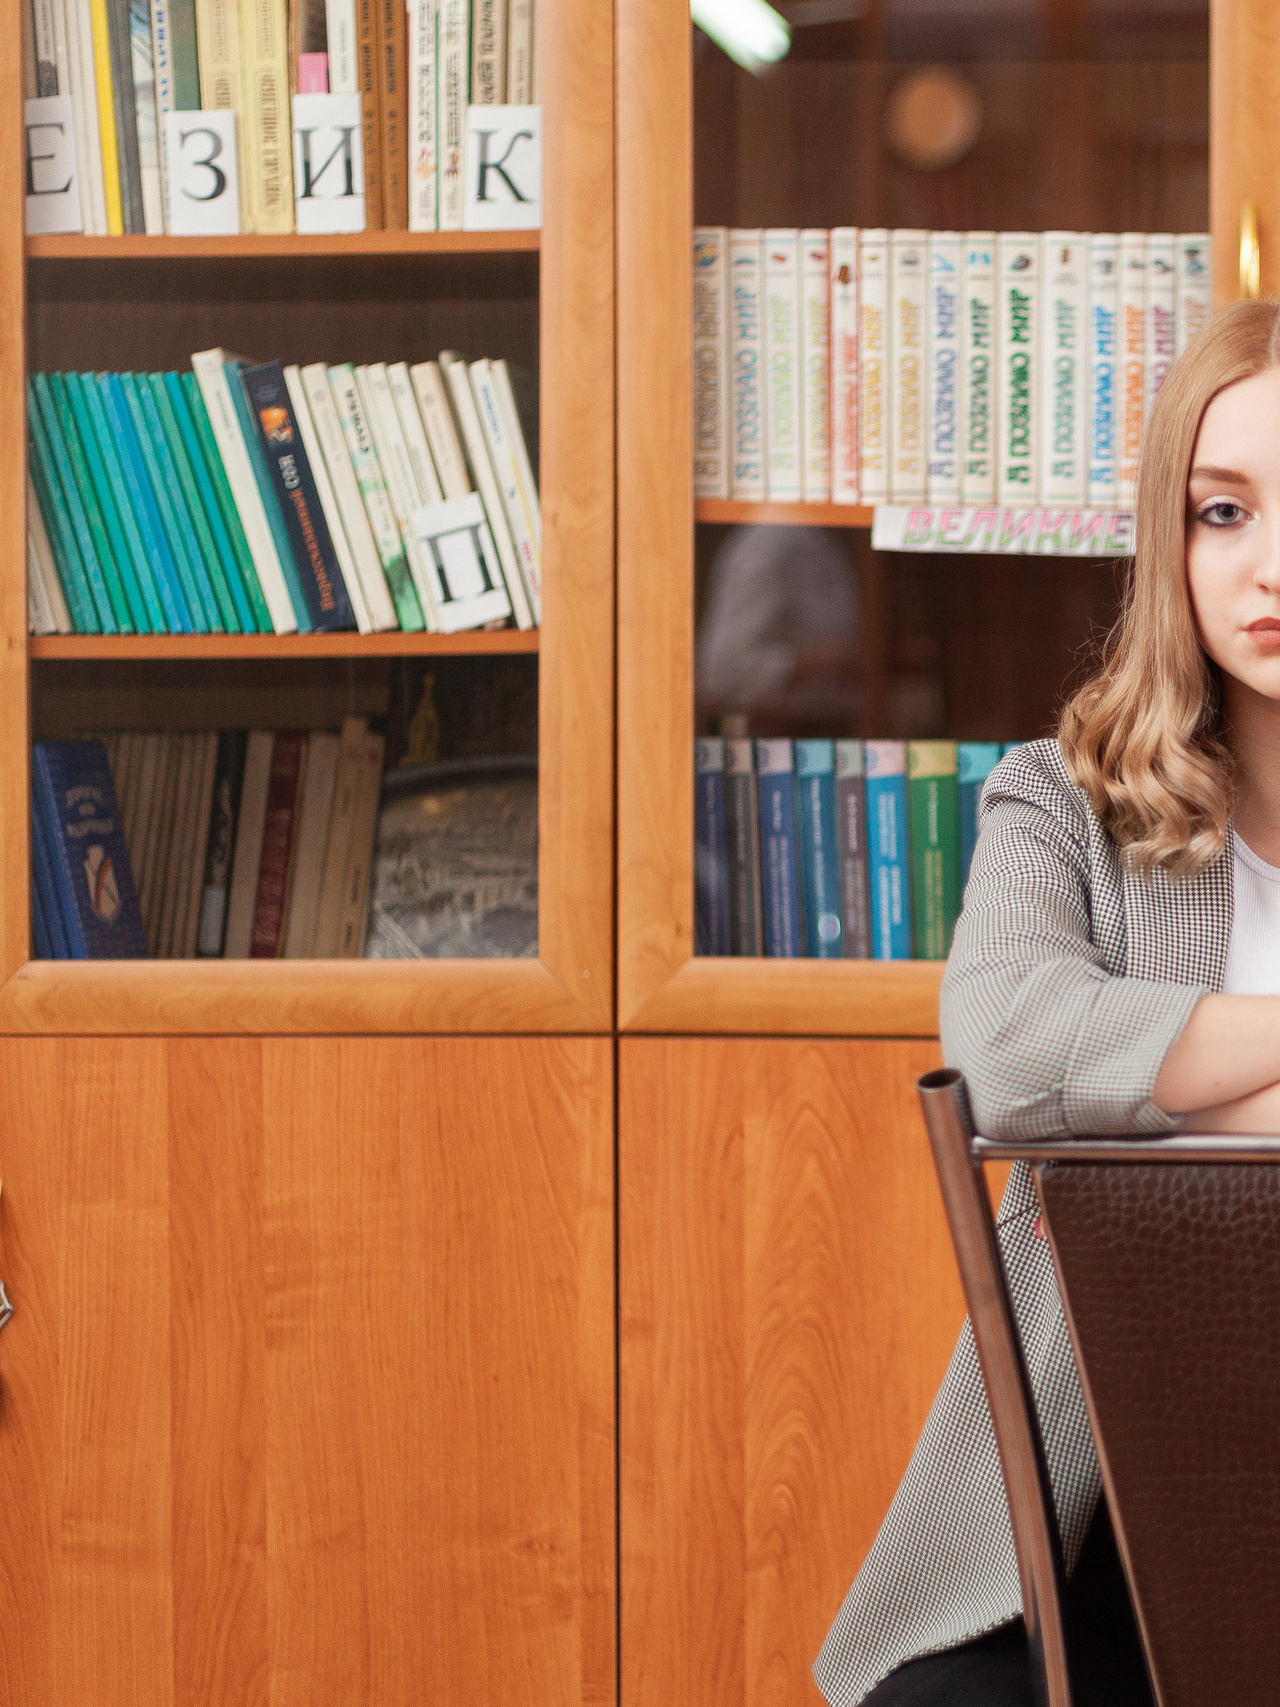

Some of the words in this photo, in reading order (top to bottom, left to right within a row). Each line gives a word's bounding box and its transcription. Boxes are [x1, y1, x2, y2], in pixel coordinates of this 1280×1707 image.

[26, 122, 73, 196] Е
[179, 127, 228, 203] З
[295, 125, 363, 199] И
[474, 129, 535, 203] К
[735, 286, 757, 340] МИР
[935, 285, 956, 339] МИР
[970, 298, 990, 348] МИР
[1009, 288, 1031, 344] МИР
[1055, 299, 1076, 349] МИР
[1094, 305, 1114, 356] МИР
[735, 349, 759, 454] ПОЗНАЮ
[863, 358, 883, 448] ПОЗНАЮ
[899, 355, 920, 451] ПОЗНАЮ
[935, 349, 956, 453] ПОЗНАЮ
[969, 355, 990, 452] ПОЗНАЮ
[1009, 352, 1031, 457] ПОЗНАЮ
[1054, 356, 1075, 453] ПОЗНАЮ
[1094, 362, 1114, 460] ПОЗНАЮ
[277, 453, 301, 490] СОН
[417, 521, 501, 605] П
[903, 509, 1131, 549] ВЕЛИКИЕ
